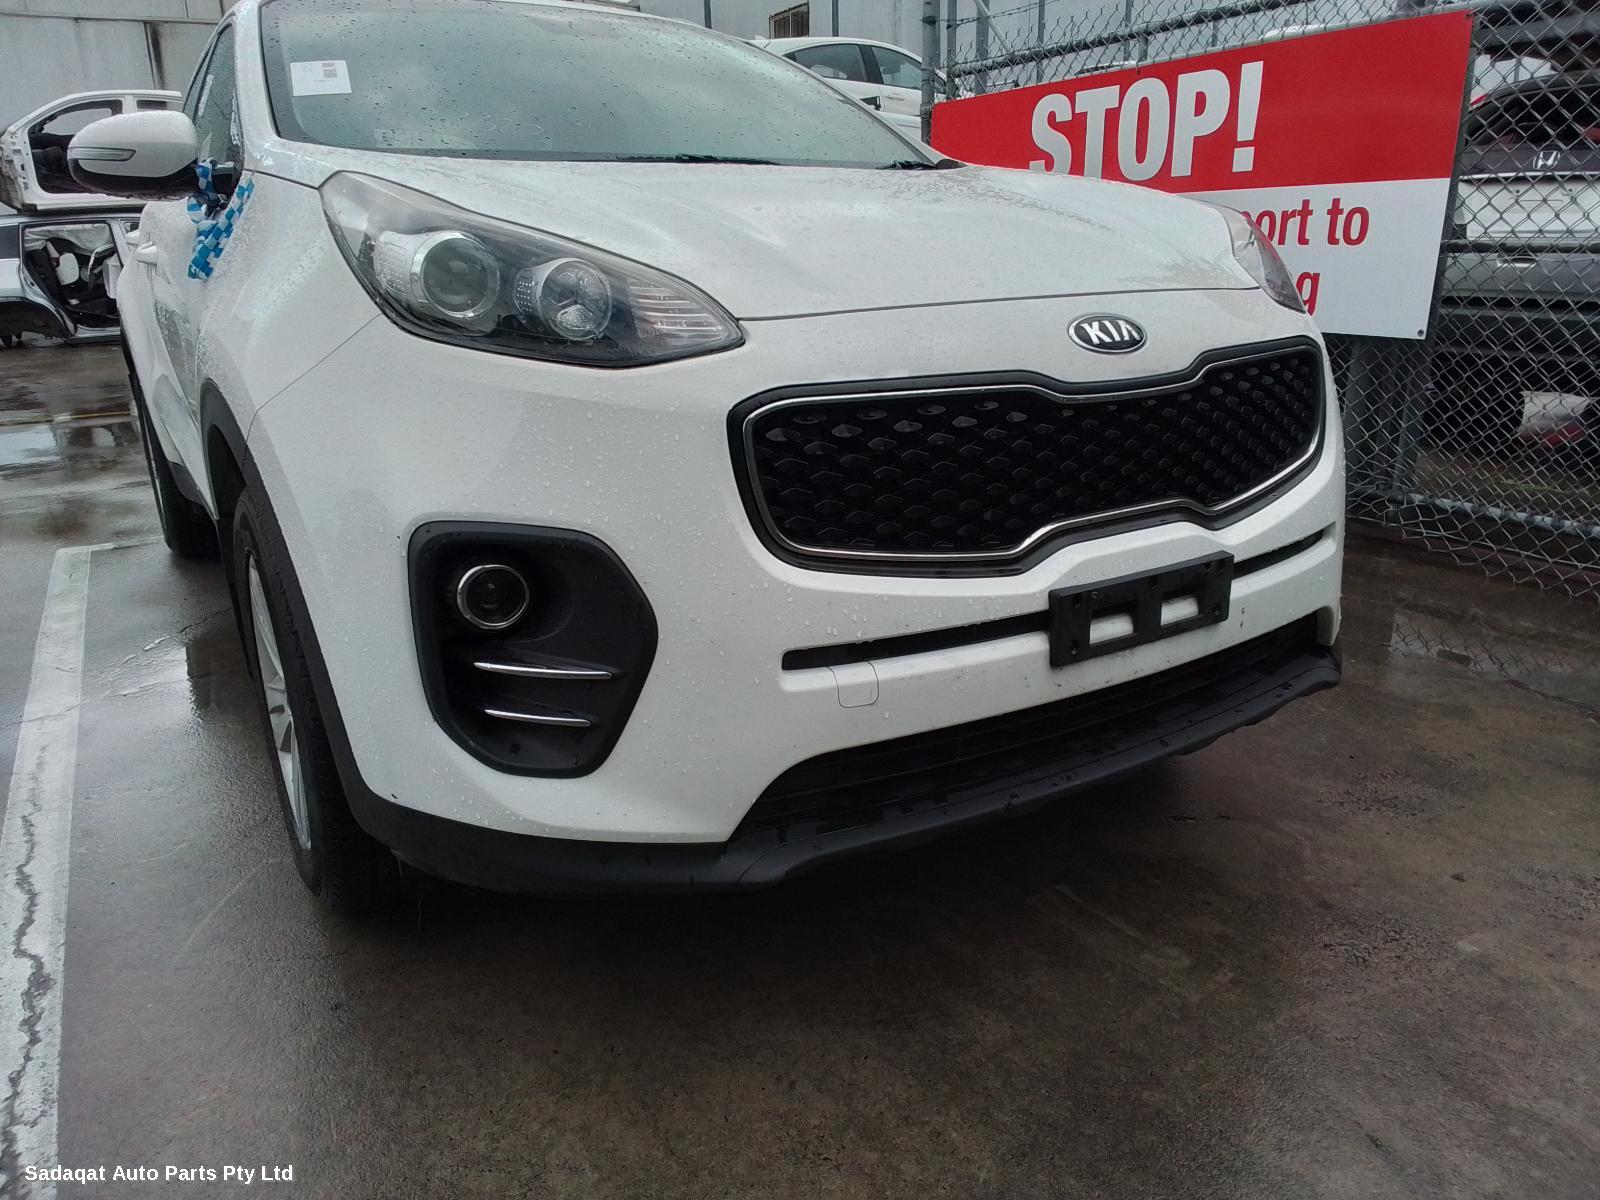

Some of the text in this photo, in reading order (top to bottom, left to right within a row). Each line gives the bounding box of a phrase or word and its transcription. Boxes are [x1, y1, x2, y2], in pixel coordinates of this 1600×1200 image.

[1028, 60, 1264, 181] STOP!
[1240, 197, 1370, 246] ort to
[1080, 319, 1141, 345] KIA
